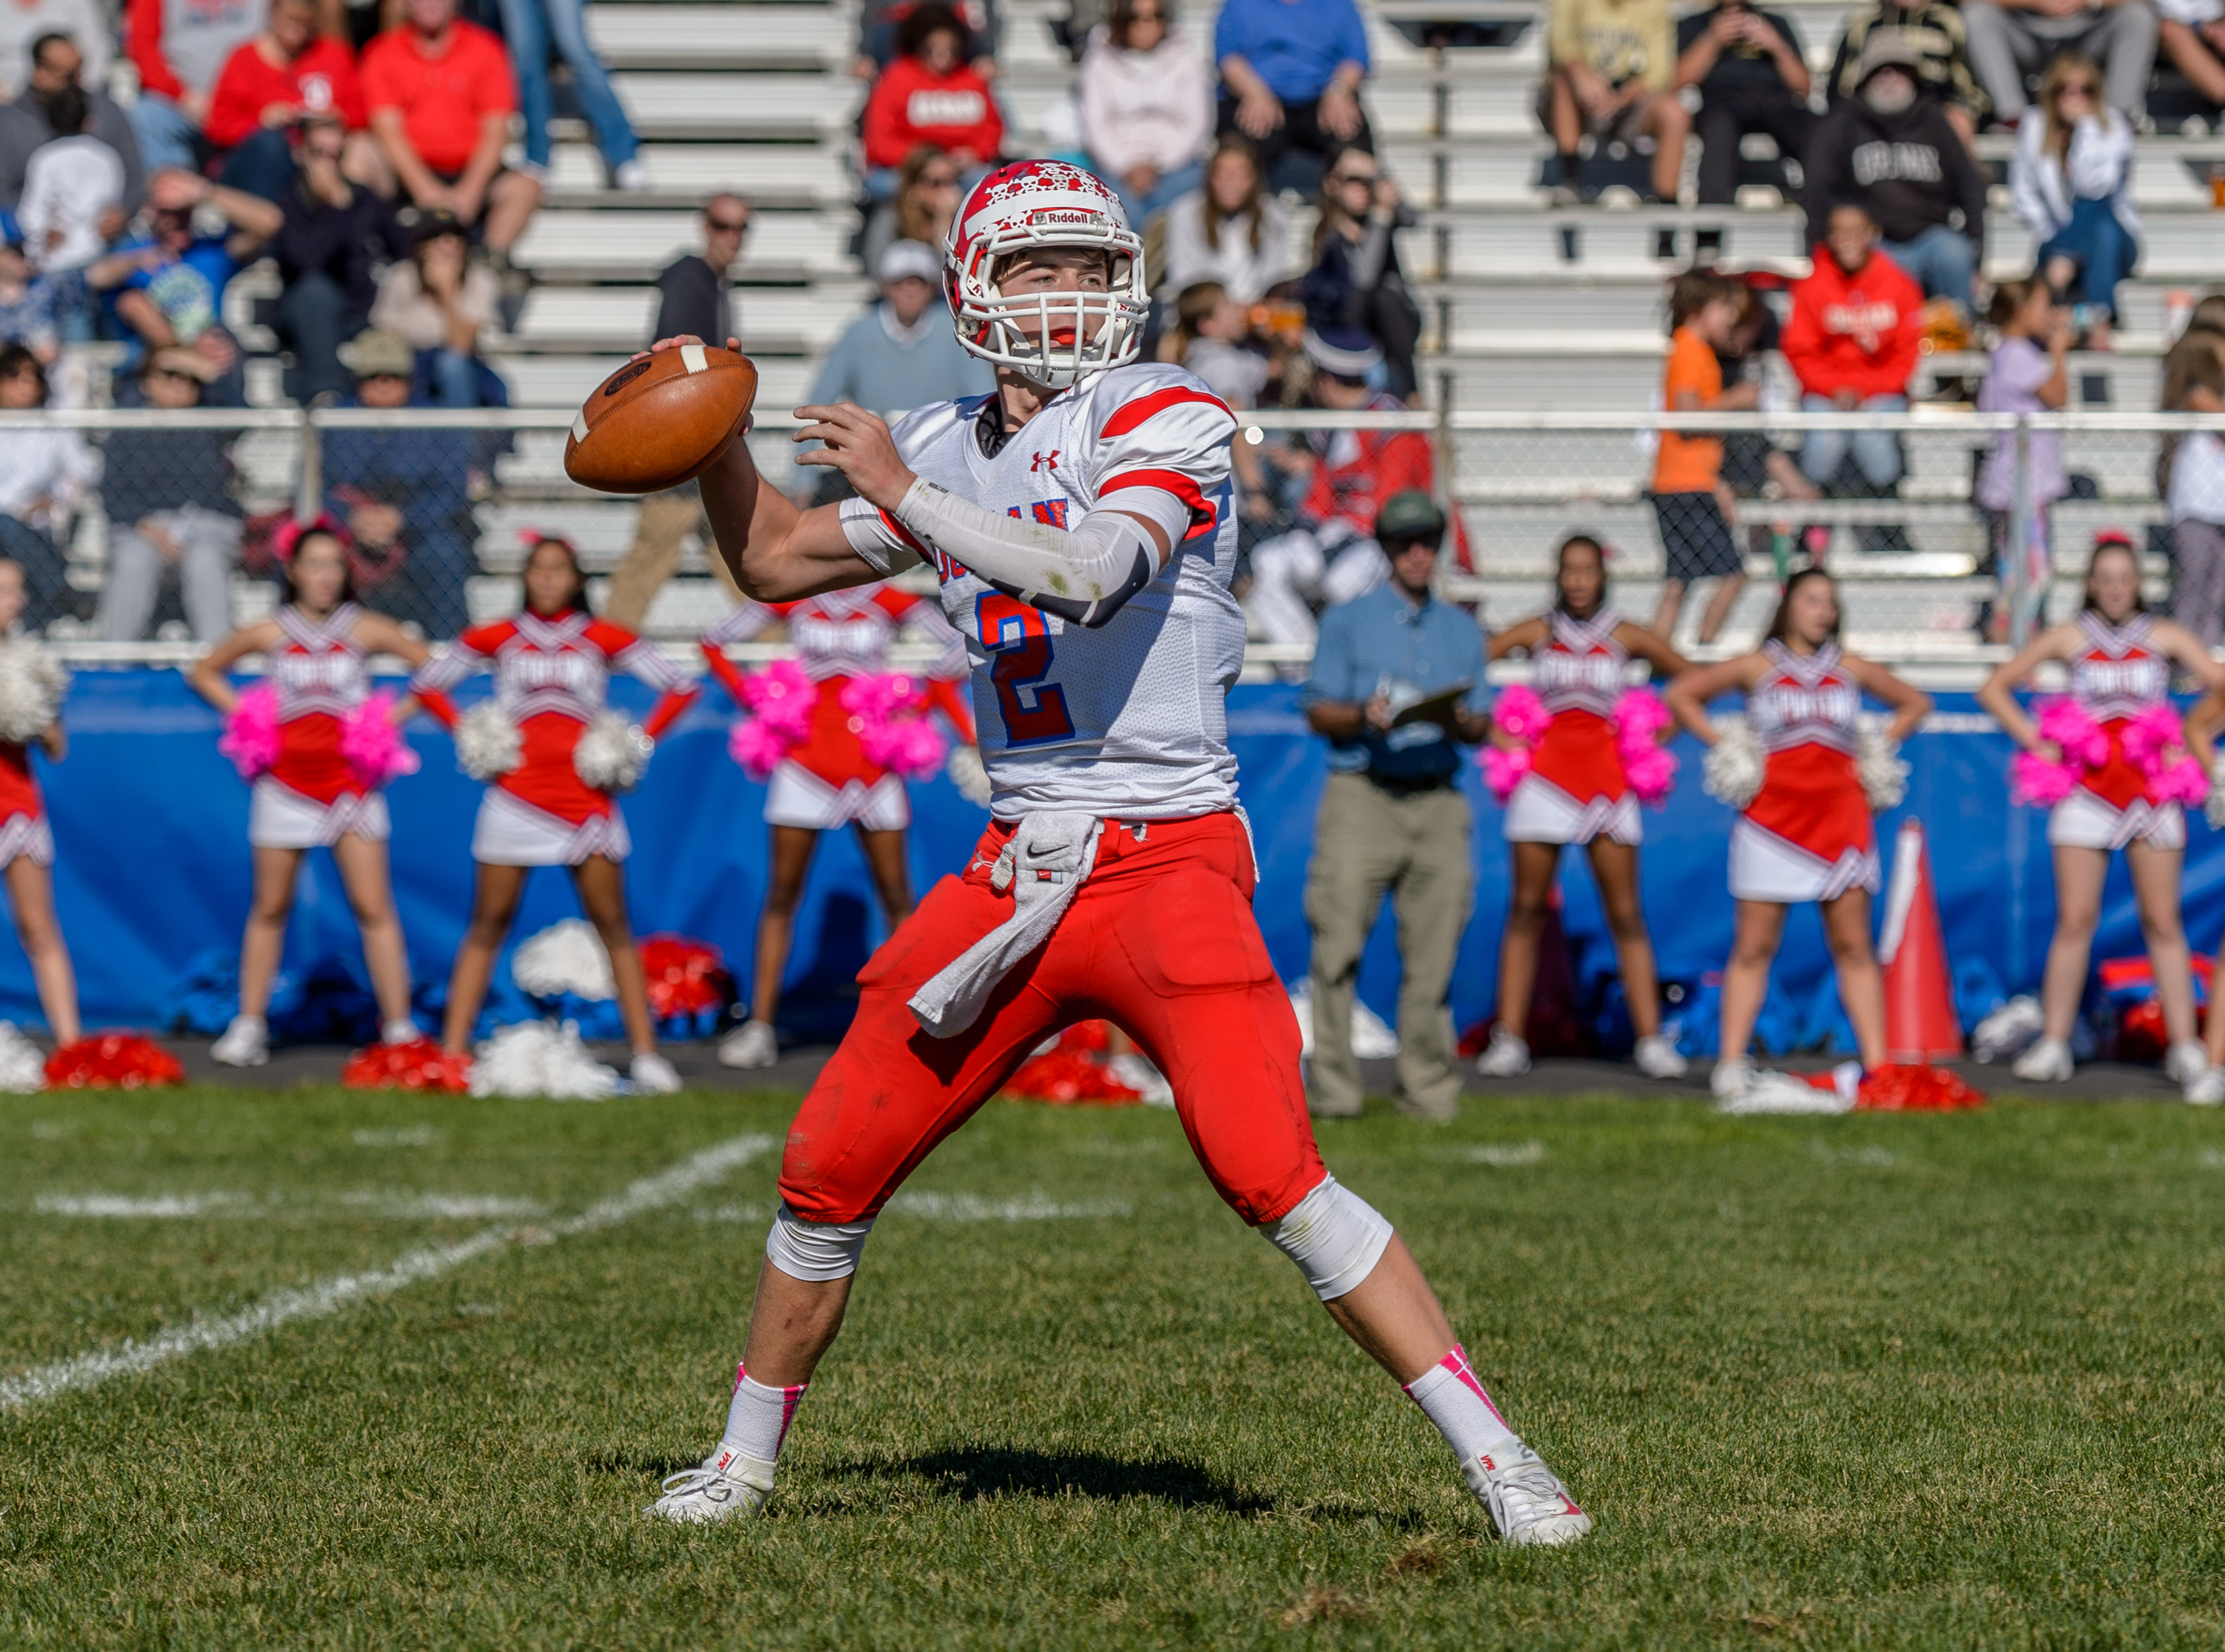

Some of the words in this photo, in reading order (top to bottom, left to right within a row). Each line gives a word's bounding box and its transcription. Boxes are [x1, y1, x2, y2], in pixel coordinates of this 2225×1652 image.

[1048, 212, 1088, 224] Riddell
[975, 589, 1076, 748] 2
[1480, 1455, 1495, 1472] VPR
